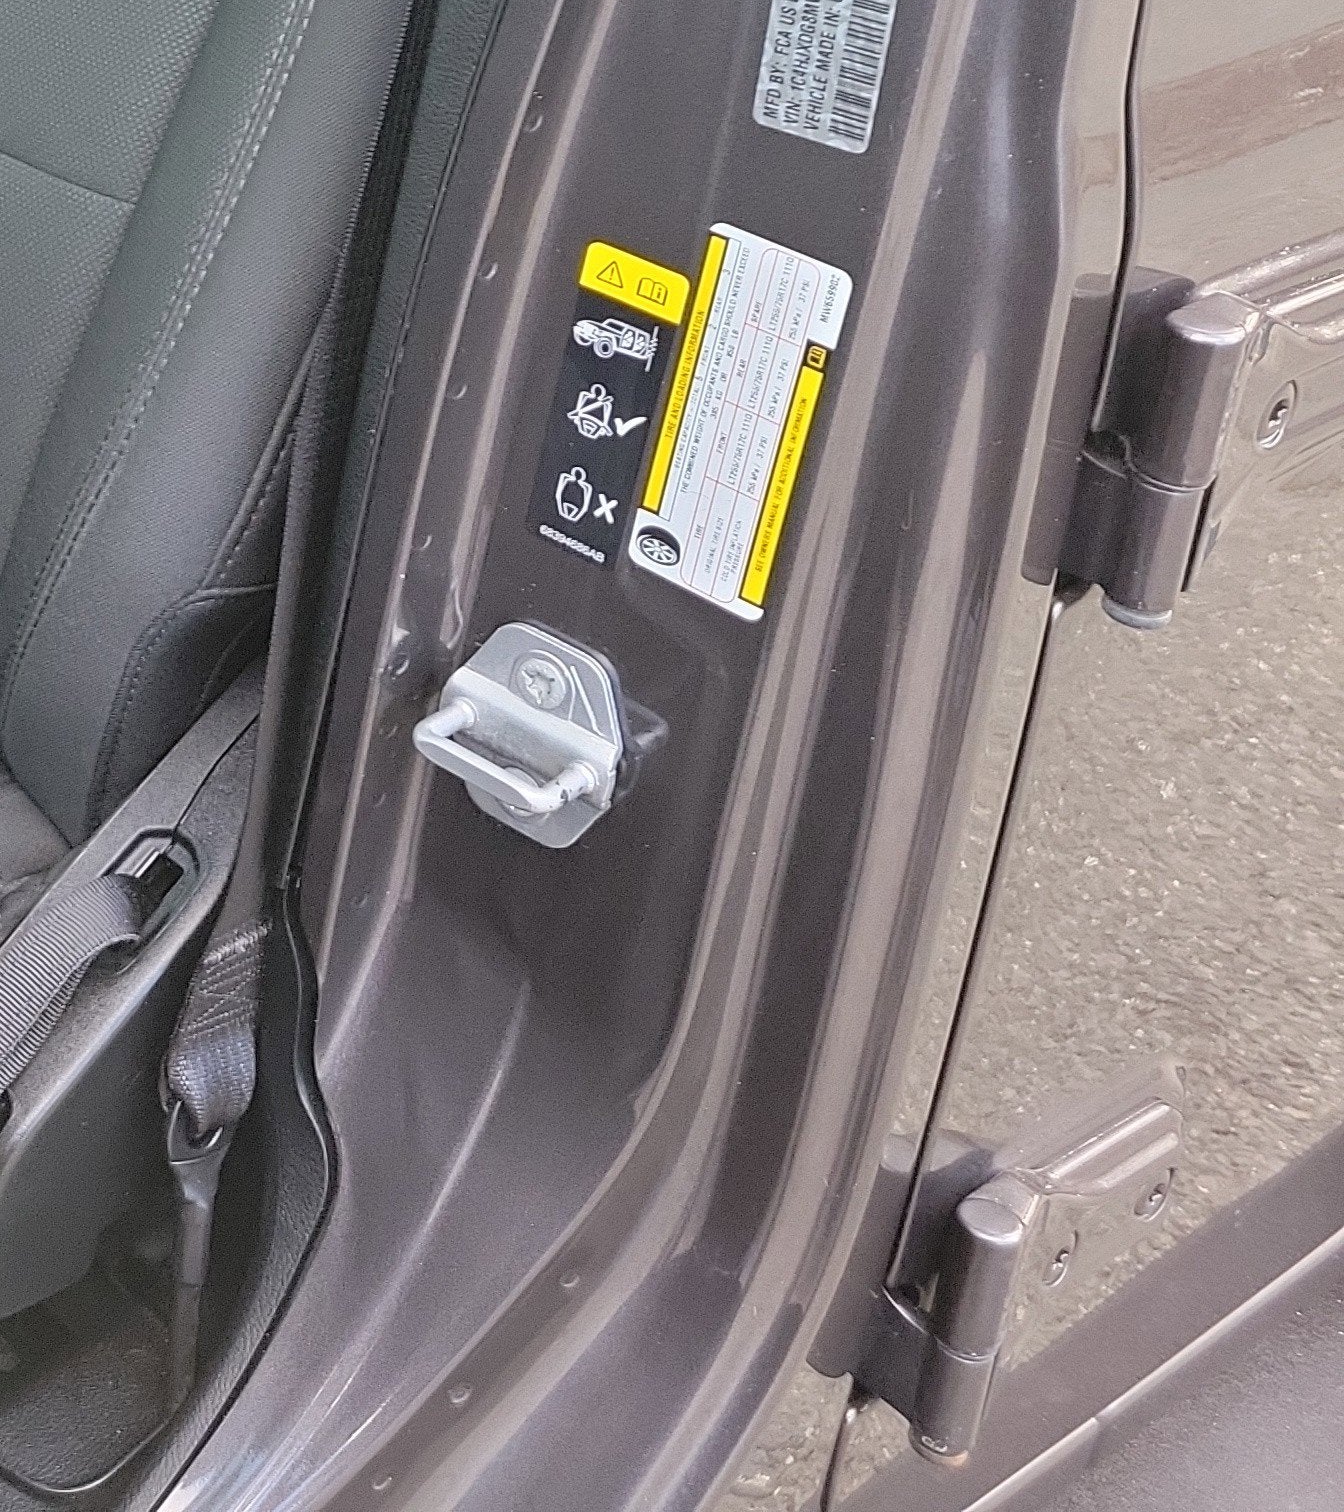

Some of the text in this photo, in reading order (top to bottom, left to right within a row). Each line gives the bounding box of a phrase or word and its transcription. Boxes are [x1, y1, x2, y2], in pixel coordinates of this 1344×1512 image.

[778, 4, 797, 26] US
[822, 5, 841, 28] IN:
[773, 28, 793, 56] FCA
[814, 30, 836, 72] MADE
[768, 59, 787, 84] BY:
[761, 86, 782, 119] MFD
[782, 95, 803, 126] VIN:
[803, 74, 828, 132] VEHICLE
[663, 308, 705, 440] TIRE AND LOADING INFORMATION
